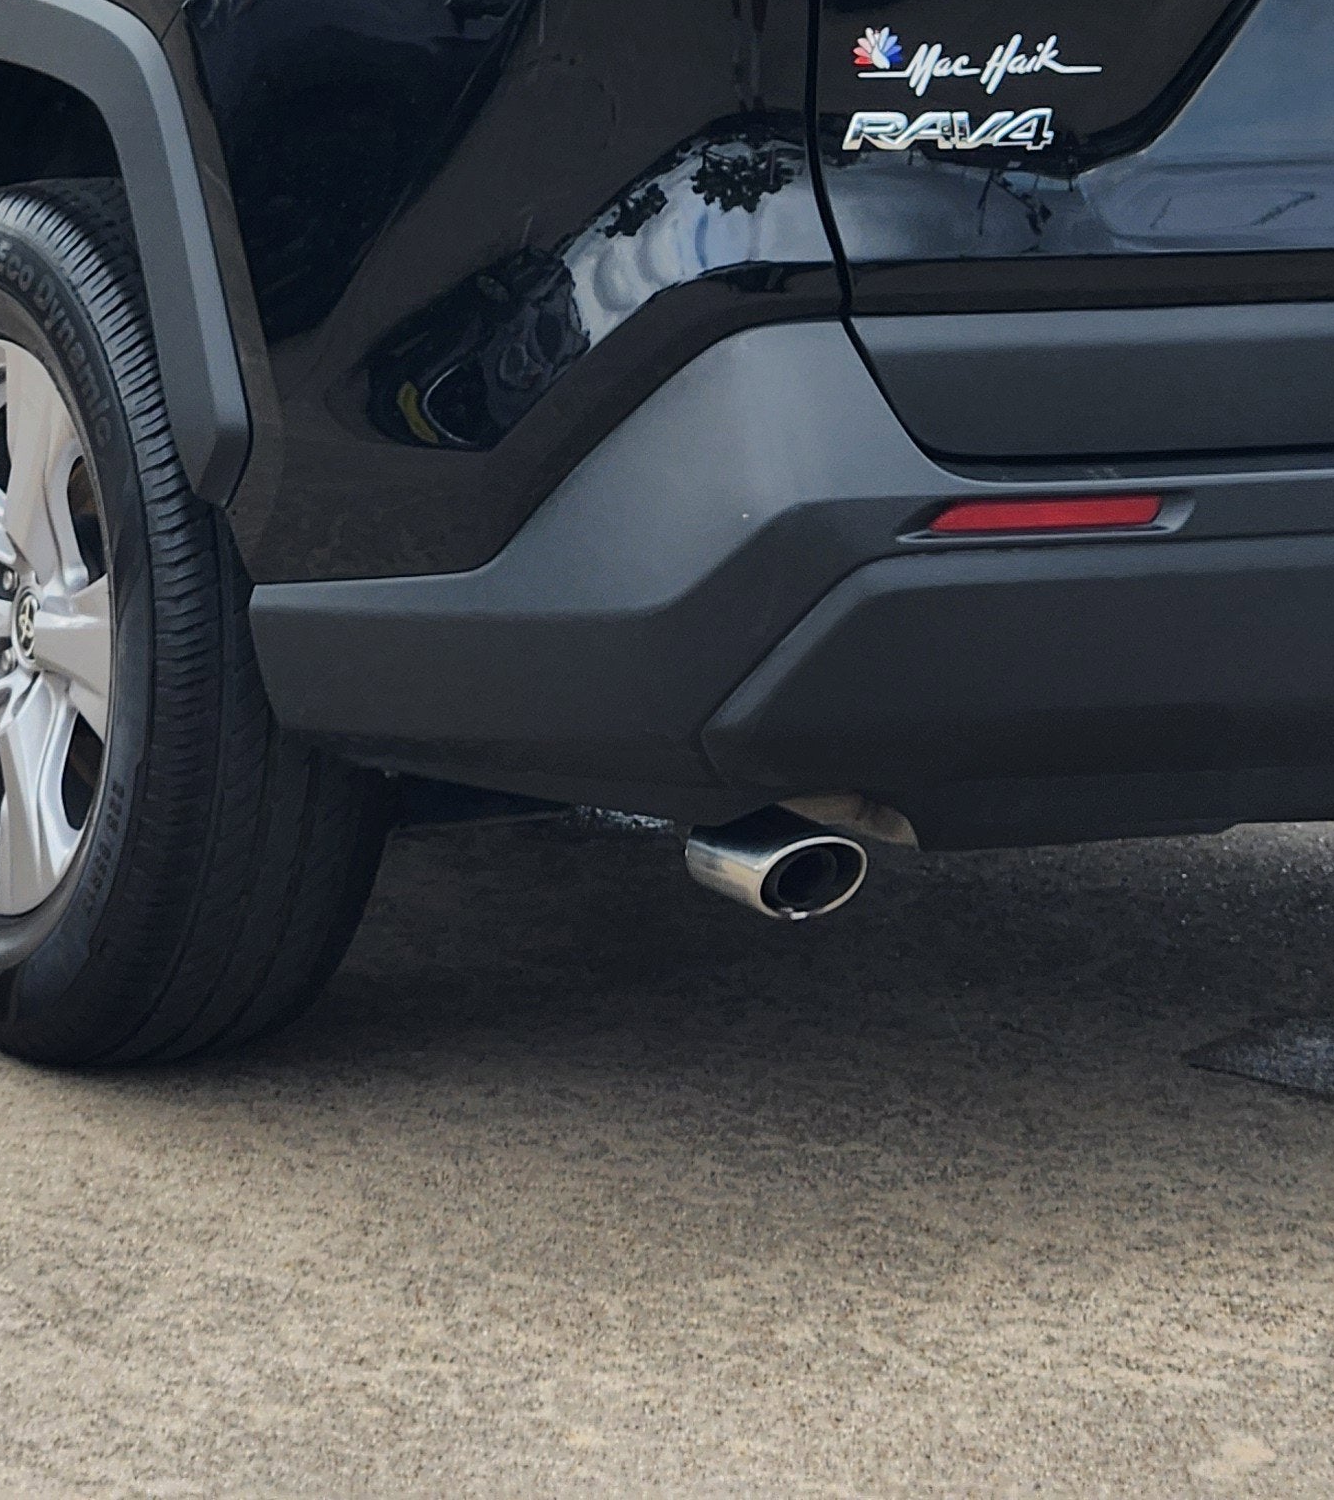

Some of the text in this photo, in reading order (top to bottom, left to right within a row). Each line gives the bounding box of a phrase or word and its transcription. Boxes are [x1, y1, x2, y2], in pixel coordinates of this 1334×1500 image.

[906, 33, 1067, 97] Mac Haik
[841, 107, 1055, 151] RAV4
